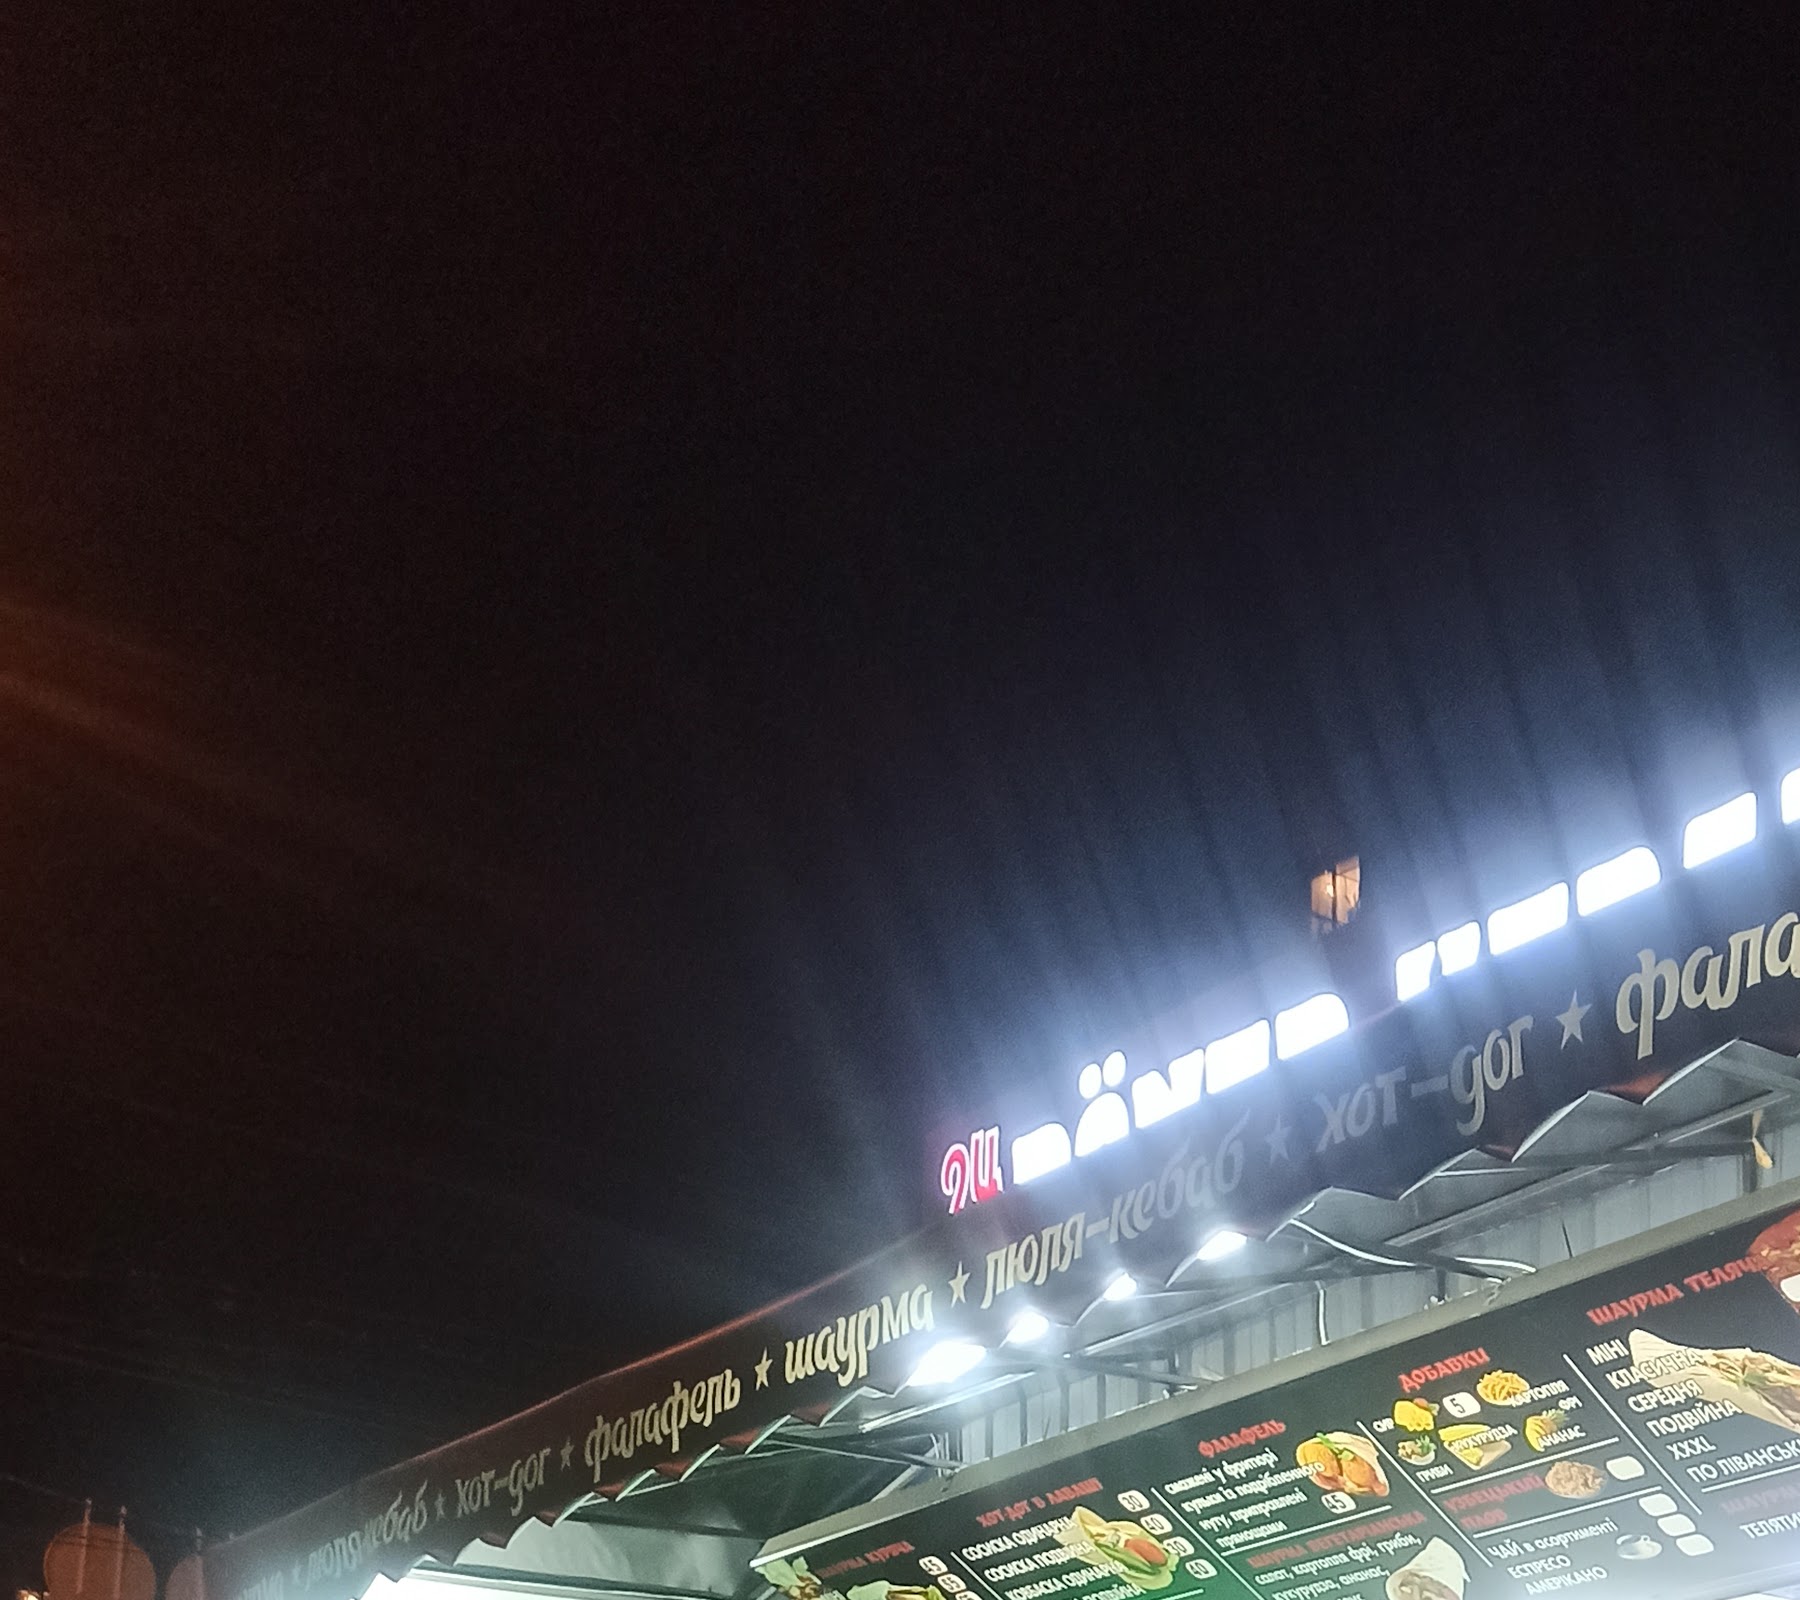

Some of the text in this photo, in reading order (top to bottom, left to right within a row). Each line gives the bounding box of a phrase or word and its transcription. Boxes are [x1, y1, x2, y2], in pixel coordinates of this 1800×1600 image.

[453, 1446, 551, 1515] хот-дог
[585, 1369, 740, 1467] фалафель
[784, 1282, 934, 1387] шаурма
[981, 1108, 1245, 1308] люля-кебаб
[1313, 1010, 1534, 1152] хот-дог
[1587, 1284, 1682, 1324] ШАУРМА
[1586, 1339, 1632, 1364] МІНІ
[1398, 1348, 1489, 1392] ДОБАВКИ
[1606, 1347, 1707, 1388] КЛАСИЧНА
[1506, 1380, 1569, 1406] КАРТОПЛЯ
[1628, 1379, 1708, 1412] СЕРЕДНЯ
[1448, 1397, 1466, 1413] 5
[1647, 1394, 1741, 1435] ПОДВІЙНА
[1372, 1417, 1398, 1432] СИР
[1534, 1425, 1585, 1447] АНАНАС
[1197, 1420, 1286, 1457] ФАЛАФЕЛЬ
[1211, 1467, 1227, 1484] у
[1415, 1463, 1453, 1482] ГРИБИ
[1686, 1463, 1717, 1482] ПО
[1121, 1494, 1143, 1510] 30
[1320, 1494, 1346, 1511] 45
[1143, 1517, 1164, 1531] 40
[962, 1535, 1017, 1560] СОСИСКА
[1165, 1540, 1187, 1555] 30
[1376, 1532, 1427, 1555] гриби,
[1487, 1517, 1617, 1559] ЧАЙ в асортименті
[918, 1559, 941, 1574] 45
[984, 1557, 1039, 1581] СОСИСКА
[1188, 1562, 1209, 1575] 40
[1507, 1554, 1570, 1578] ЕСПРЕСО
[940, 1576, 960, 1590] 55
[1525, 1566, 1606, 1595] АМЕРІКАНО
